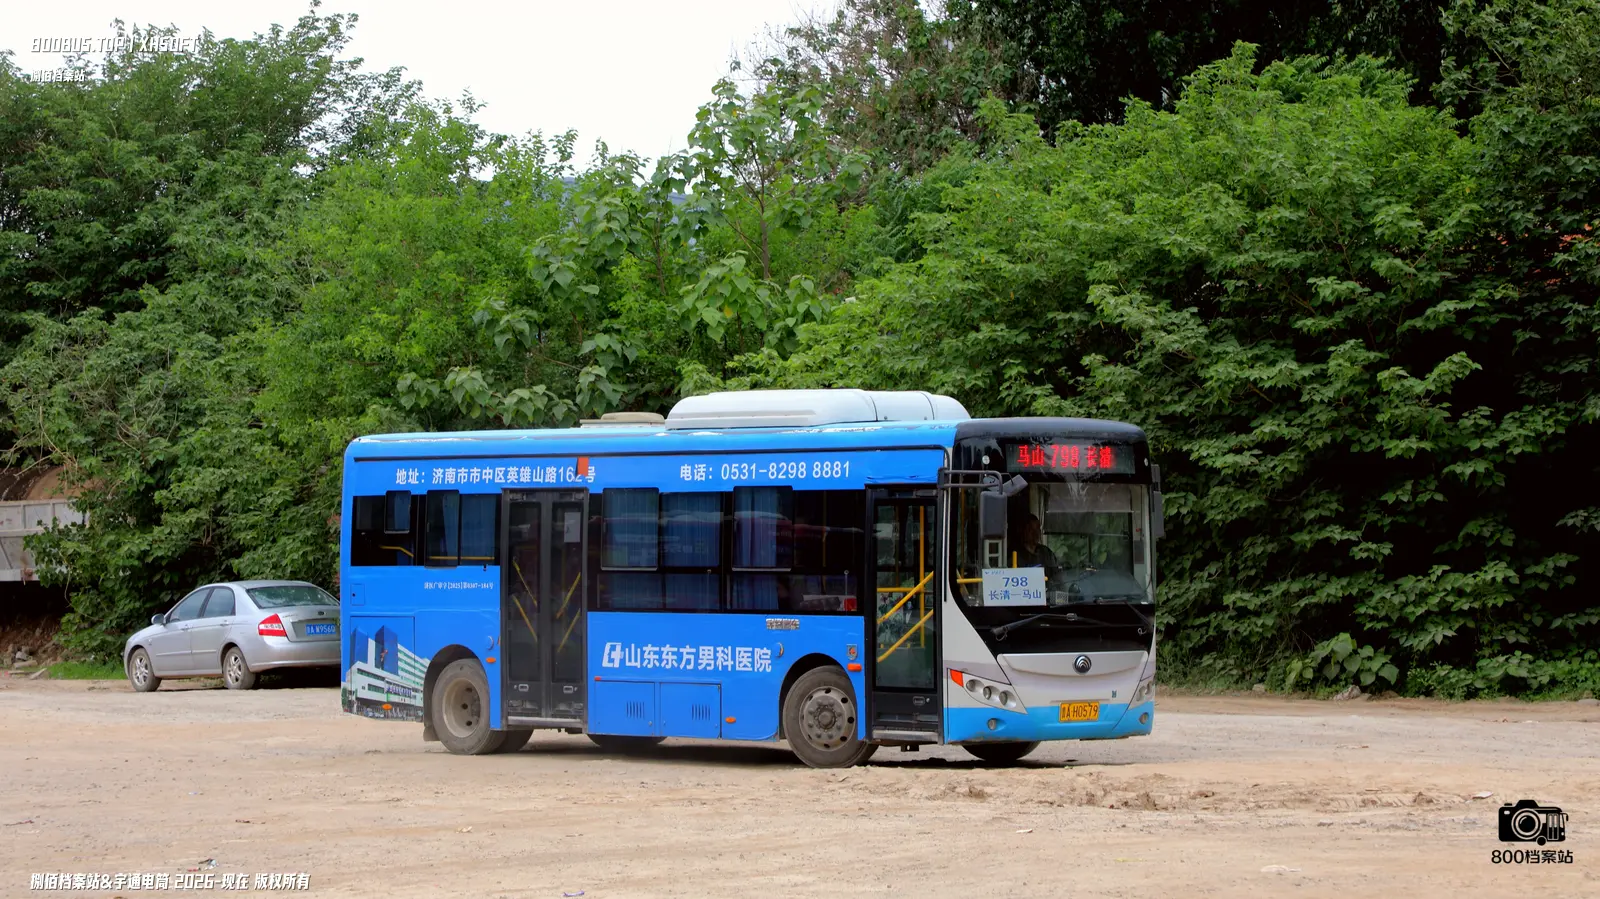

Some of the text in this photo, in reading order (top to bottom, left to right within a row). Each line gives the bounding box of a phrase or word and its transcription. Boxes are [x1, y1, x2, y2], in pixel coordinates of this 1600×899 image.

[1017, 445, 1113, 468] 马山 798 长清
[812, 460, 851, 478] 8881
[1002, 576, 1029, 588] 798
[625, 643, 772, 673] 山东东方男科医院
